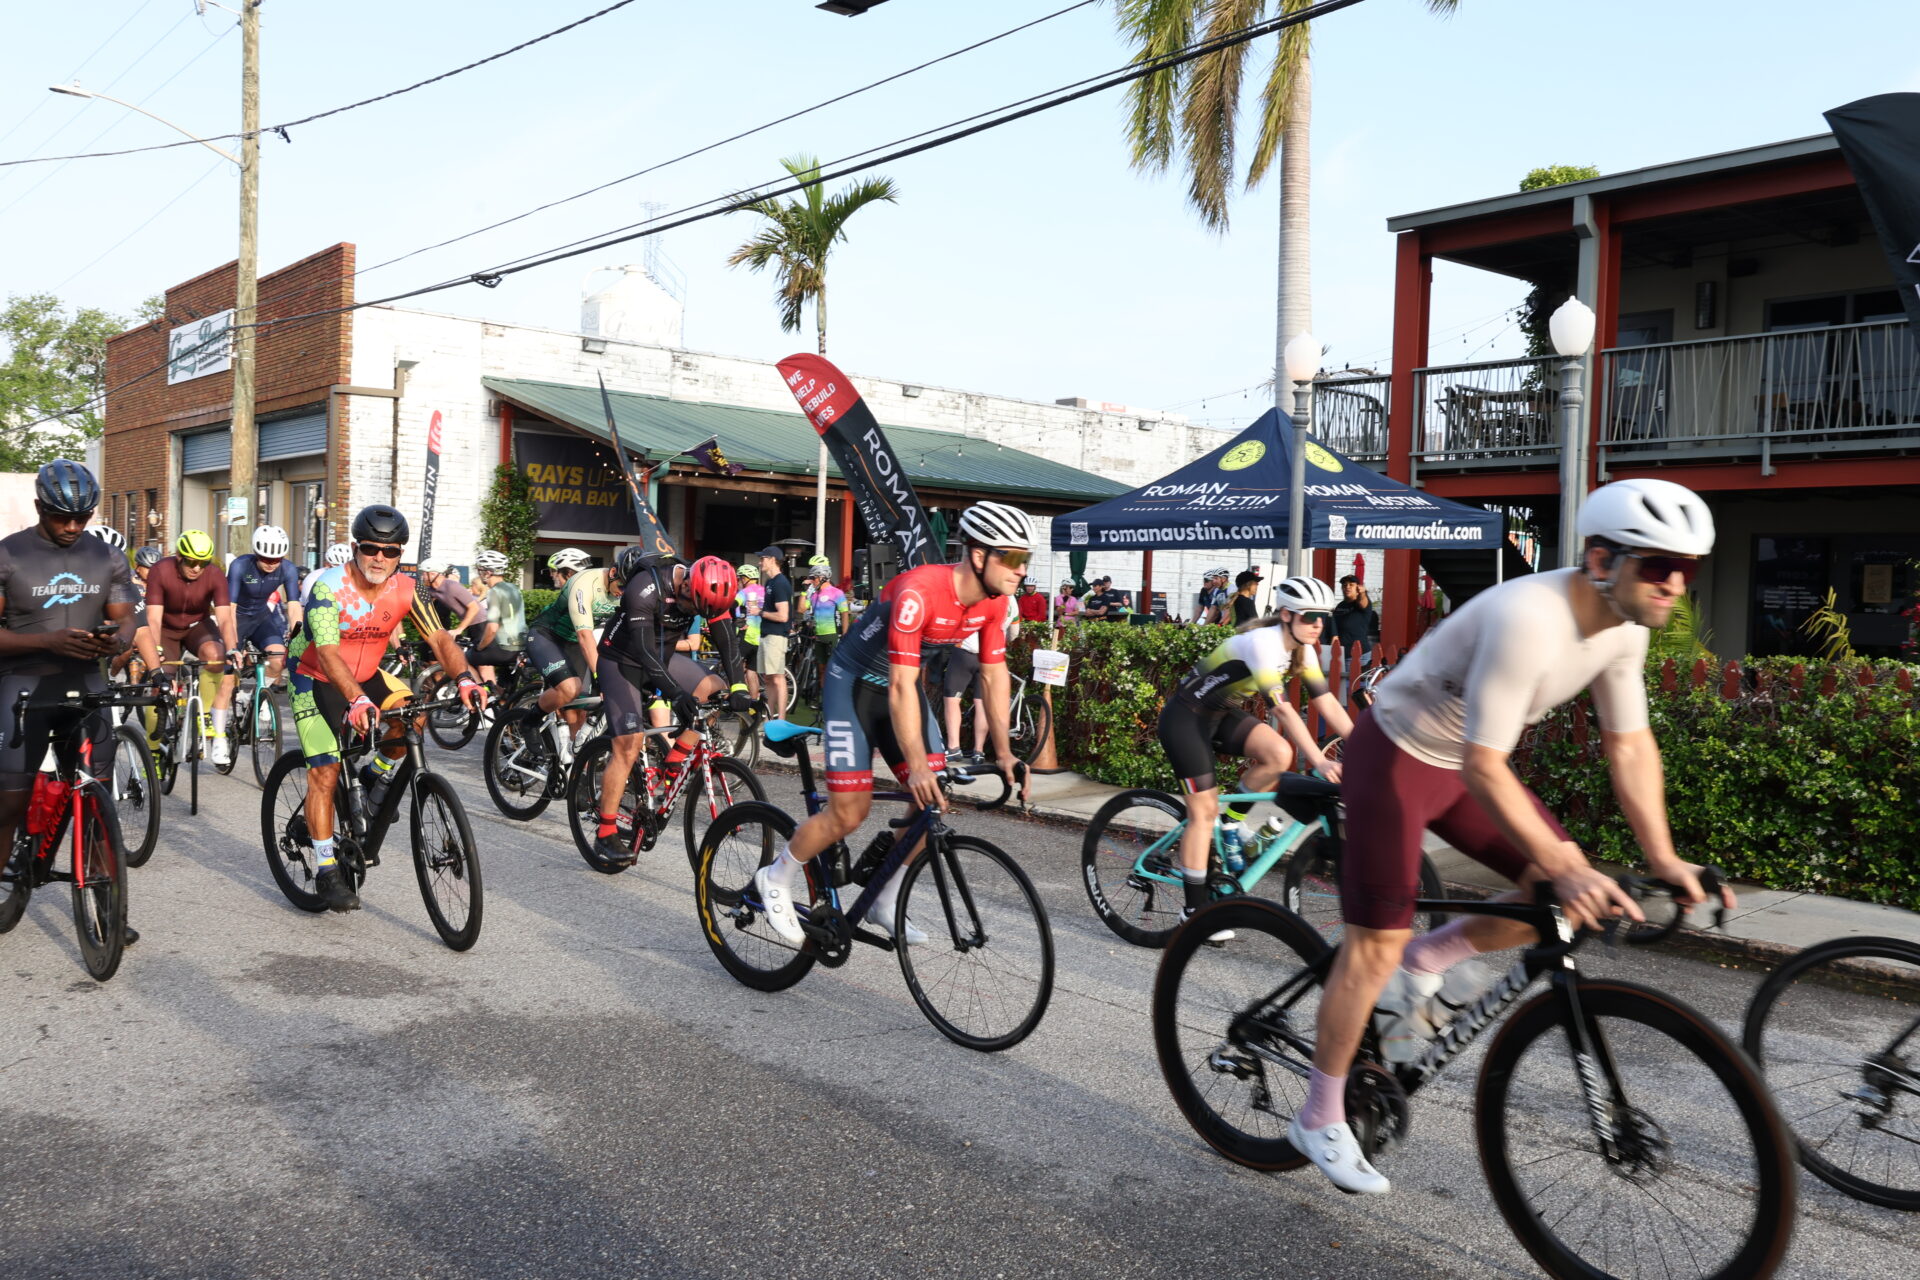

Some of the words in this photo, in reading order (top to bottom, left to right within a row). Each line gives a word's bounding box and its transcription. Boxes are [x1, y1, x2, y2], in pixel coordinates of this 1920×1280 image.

[787, 370, 804, 386] WE
[794, 379, 816, 401] HELP
[803, 382, 836, 413] REBUILD
[527, 463, 585, 486] RAYS
[587, 467, 615, 488] UP
[527, 486, 583, 504] TAMPA
[586, 490, 619, 506] BAY
[863, 427, 927, 548] ROMAN
[1142, 482, 1229, 497] ROMAN
[1303, 484, 1372, 497] ROMAN
[1187, 494, 1279, 506] AUSTIN
[1365, 496, 1432, 506] AUSTIN
[860, 500, 886, 545] INJURY
[1100, 520, 1275, 543] romanaustin.com
[1355, 519, 1482, 541] romanaustin.com
[32, 586, 57, 596] TEAM
[59, 584, 101, 593] PINELLAS
[898, 598, 919, 626] B
[662, 768, 693, 819] LOOK
[1086, 864, 1111, 916] HYPER
